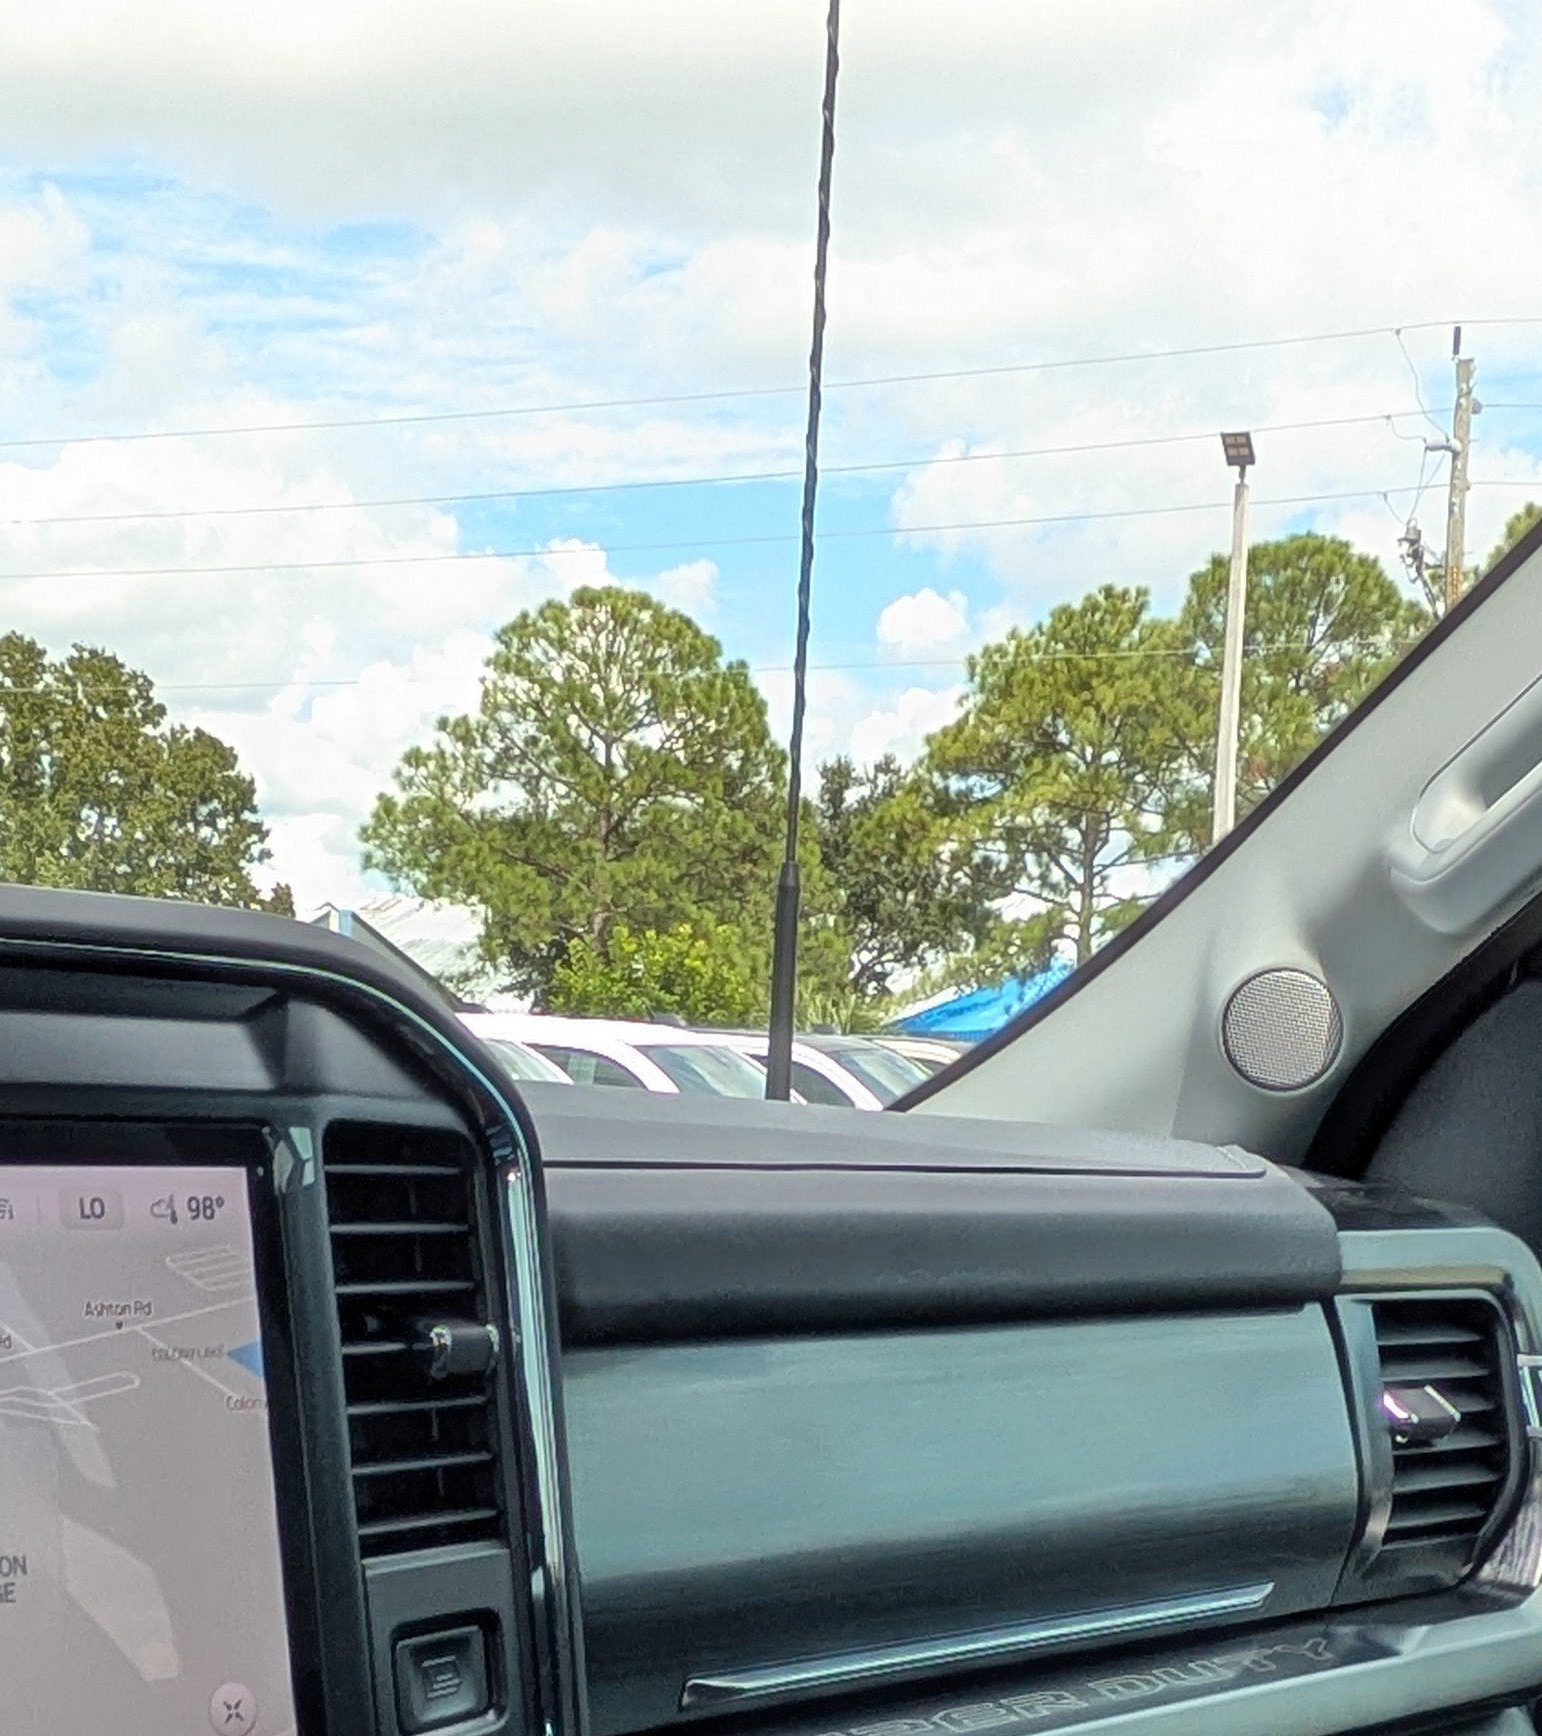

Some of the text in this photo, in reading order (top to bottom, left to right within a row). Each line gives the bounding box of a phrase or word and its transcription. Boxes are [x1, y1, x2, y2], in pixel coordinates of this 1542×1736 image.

[79, 1198, 105, 1220] LO
[188, 1197, 225, 1221] 98°
[84, 1300, 153, 1318] Ashton Rd
[1085, 1636, 1333, 1701] DUTY
